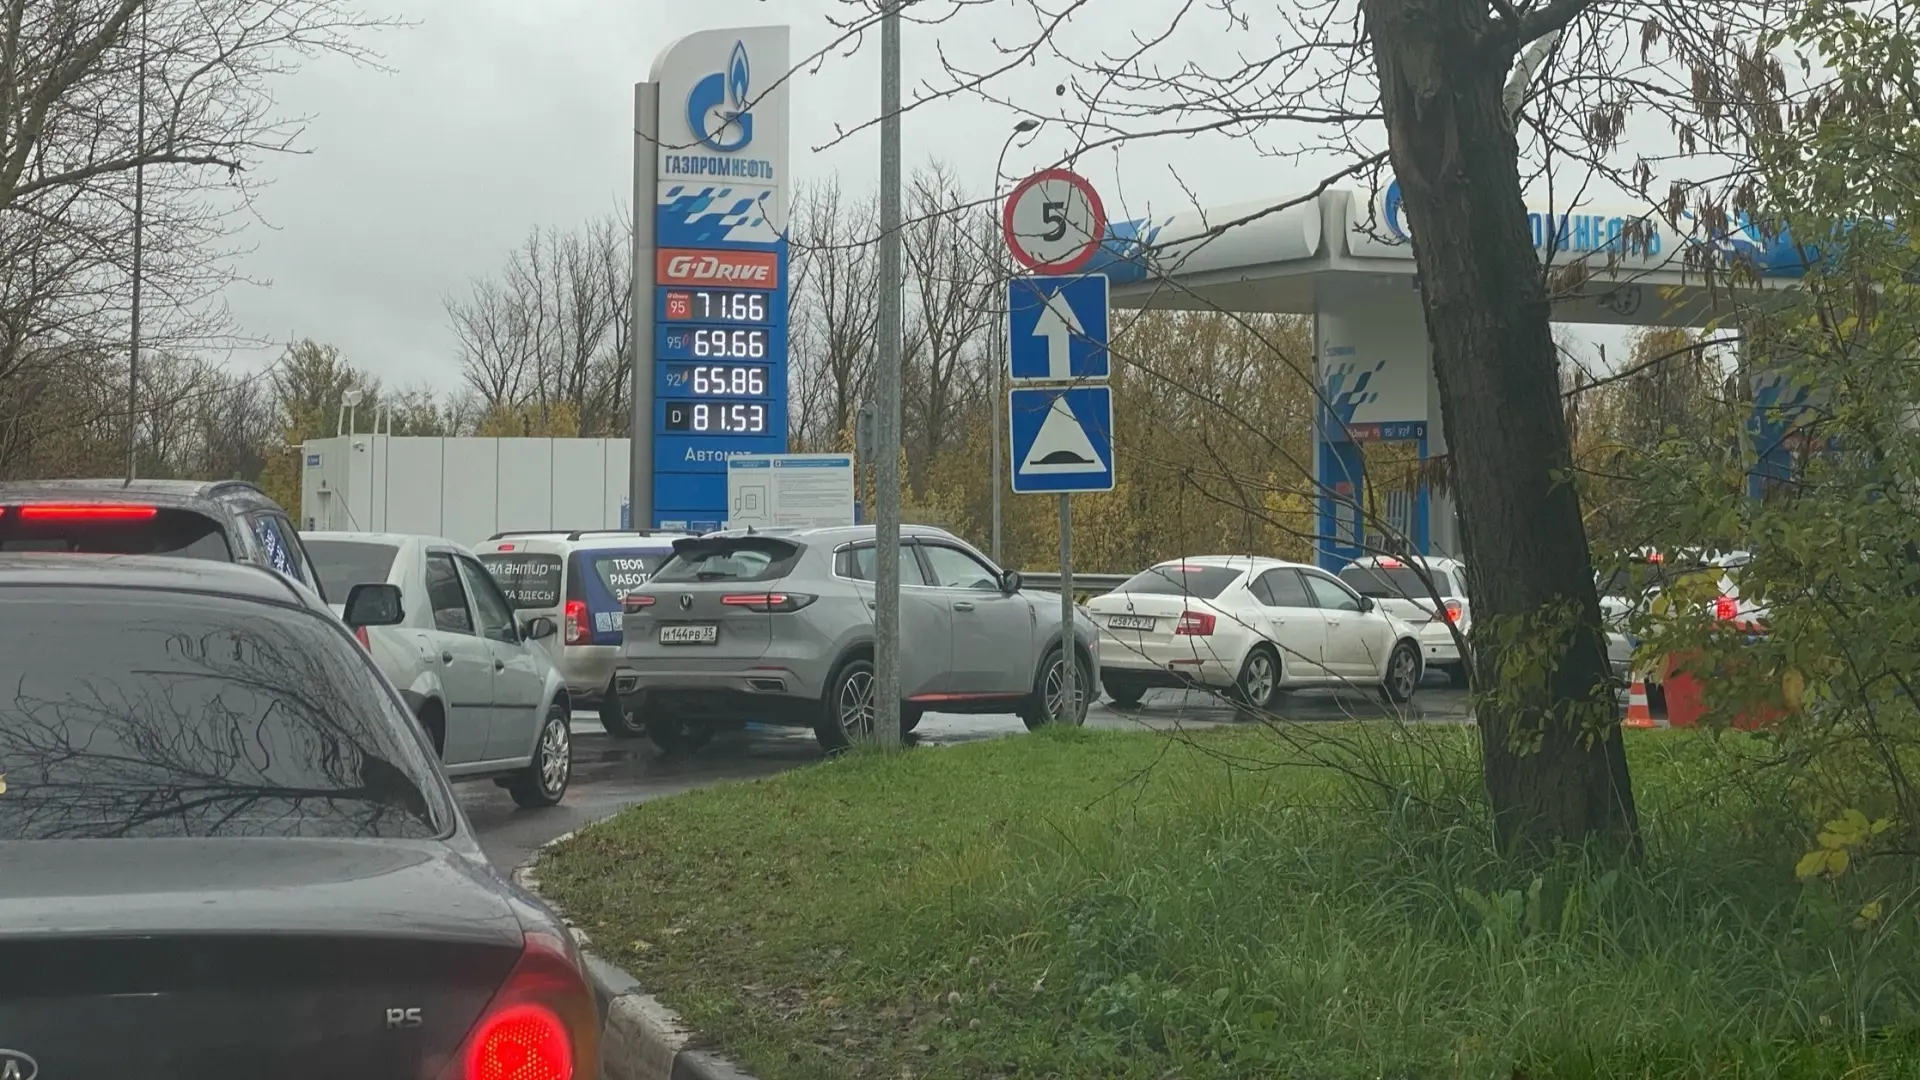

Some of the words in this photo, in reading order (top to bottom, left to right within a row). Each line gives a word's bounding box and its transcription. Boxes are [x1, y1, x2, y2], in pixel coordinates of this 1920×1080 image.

[665, 155, 773, 179] ГАЗПРОМНЕФТЬ
[1043, 202, 1067, 241] 5
[670, 300, 686, 314] 95
[697, 292, 763, 320] 71.66
[666, 336, 682, 349] 95
[695, 330, 763, 357] 69.66
[666, 374, 681, 387] 92
[694, 367, 763, 394] 65.86
[672, 410, 682, 423] D
[694, 404, 763, 432] 81.53
[612, 558, 644, 570] ТВОЯ
[610, 573, 652, 585] РАБОТ
[518, 590, 555, 602] ЗДЕСЬ!
